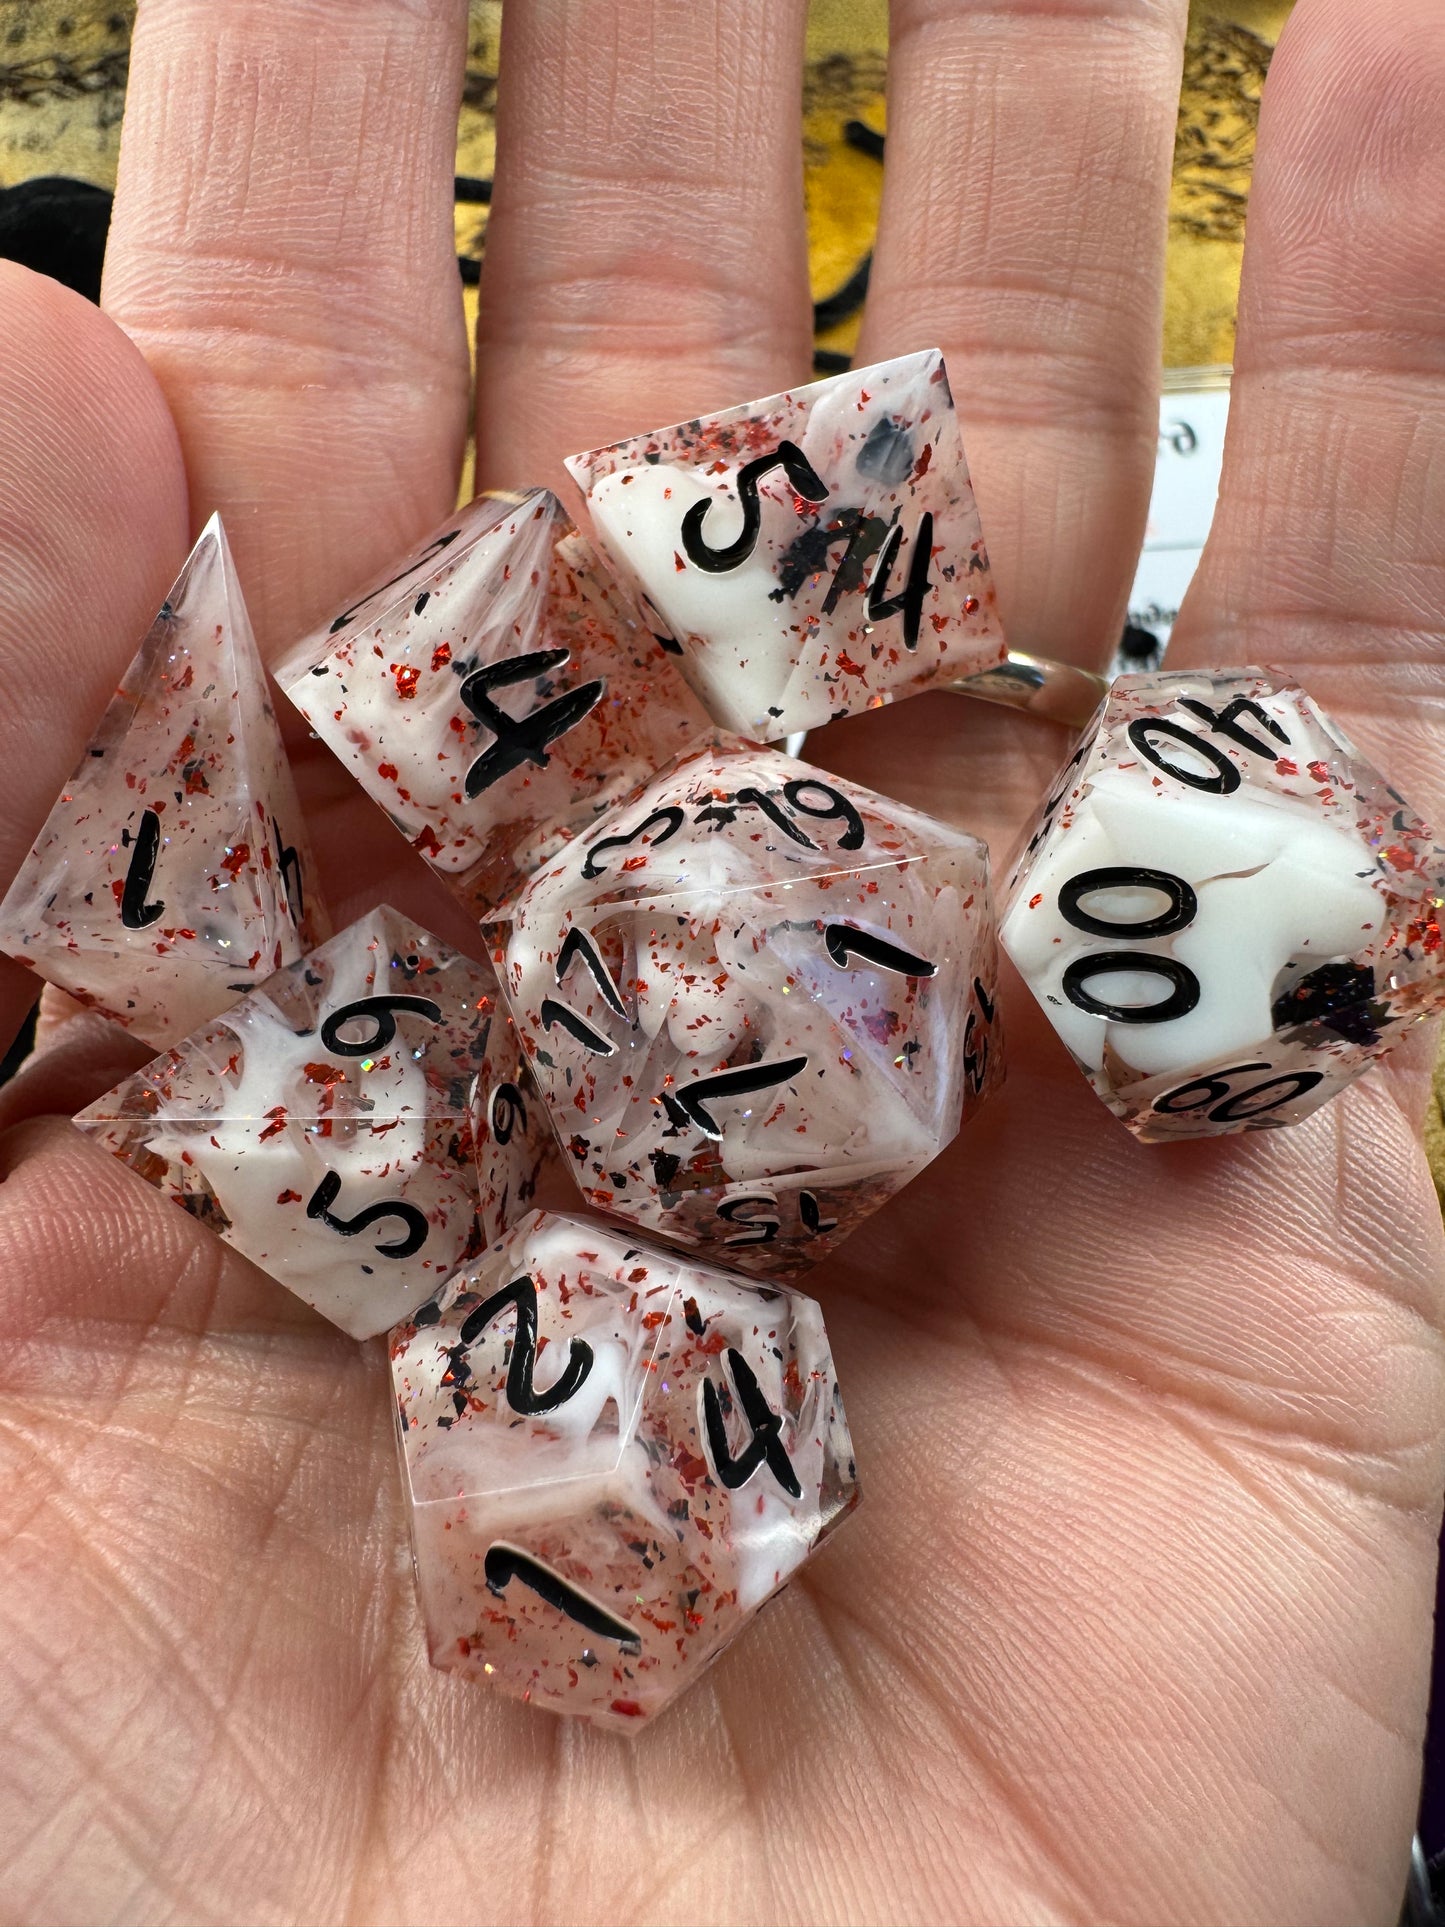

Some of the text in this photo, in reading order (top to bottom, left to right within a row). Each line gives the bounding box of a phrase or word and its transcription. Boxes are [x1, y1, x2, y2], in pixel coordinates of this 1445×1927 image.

[682, 440, 829, 574] 5
[864, 512, 933, 652] 4
[460, 648, 605, 800] 4
[1126, 698, 1291, 794] 40
[580, 806, 684, 879] 3
[738, 779, 865, 850] 19
[541, 927, 628, 1057] 17
[1058, 867, 1200, 1023] 00
[675, 1056, 808, 1142] 7
[1153, 1062, 1323, 1122] 60
[306, 1170, 428, 1258] 5
[715, 1191, 837, 1247] 15
[459, 1275, 594, 1416] 2
[700, 1348, 803, 1499] 4
[485, 1540, 642, 1656] 1
